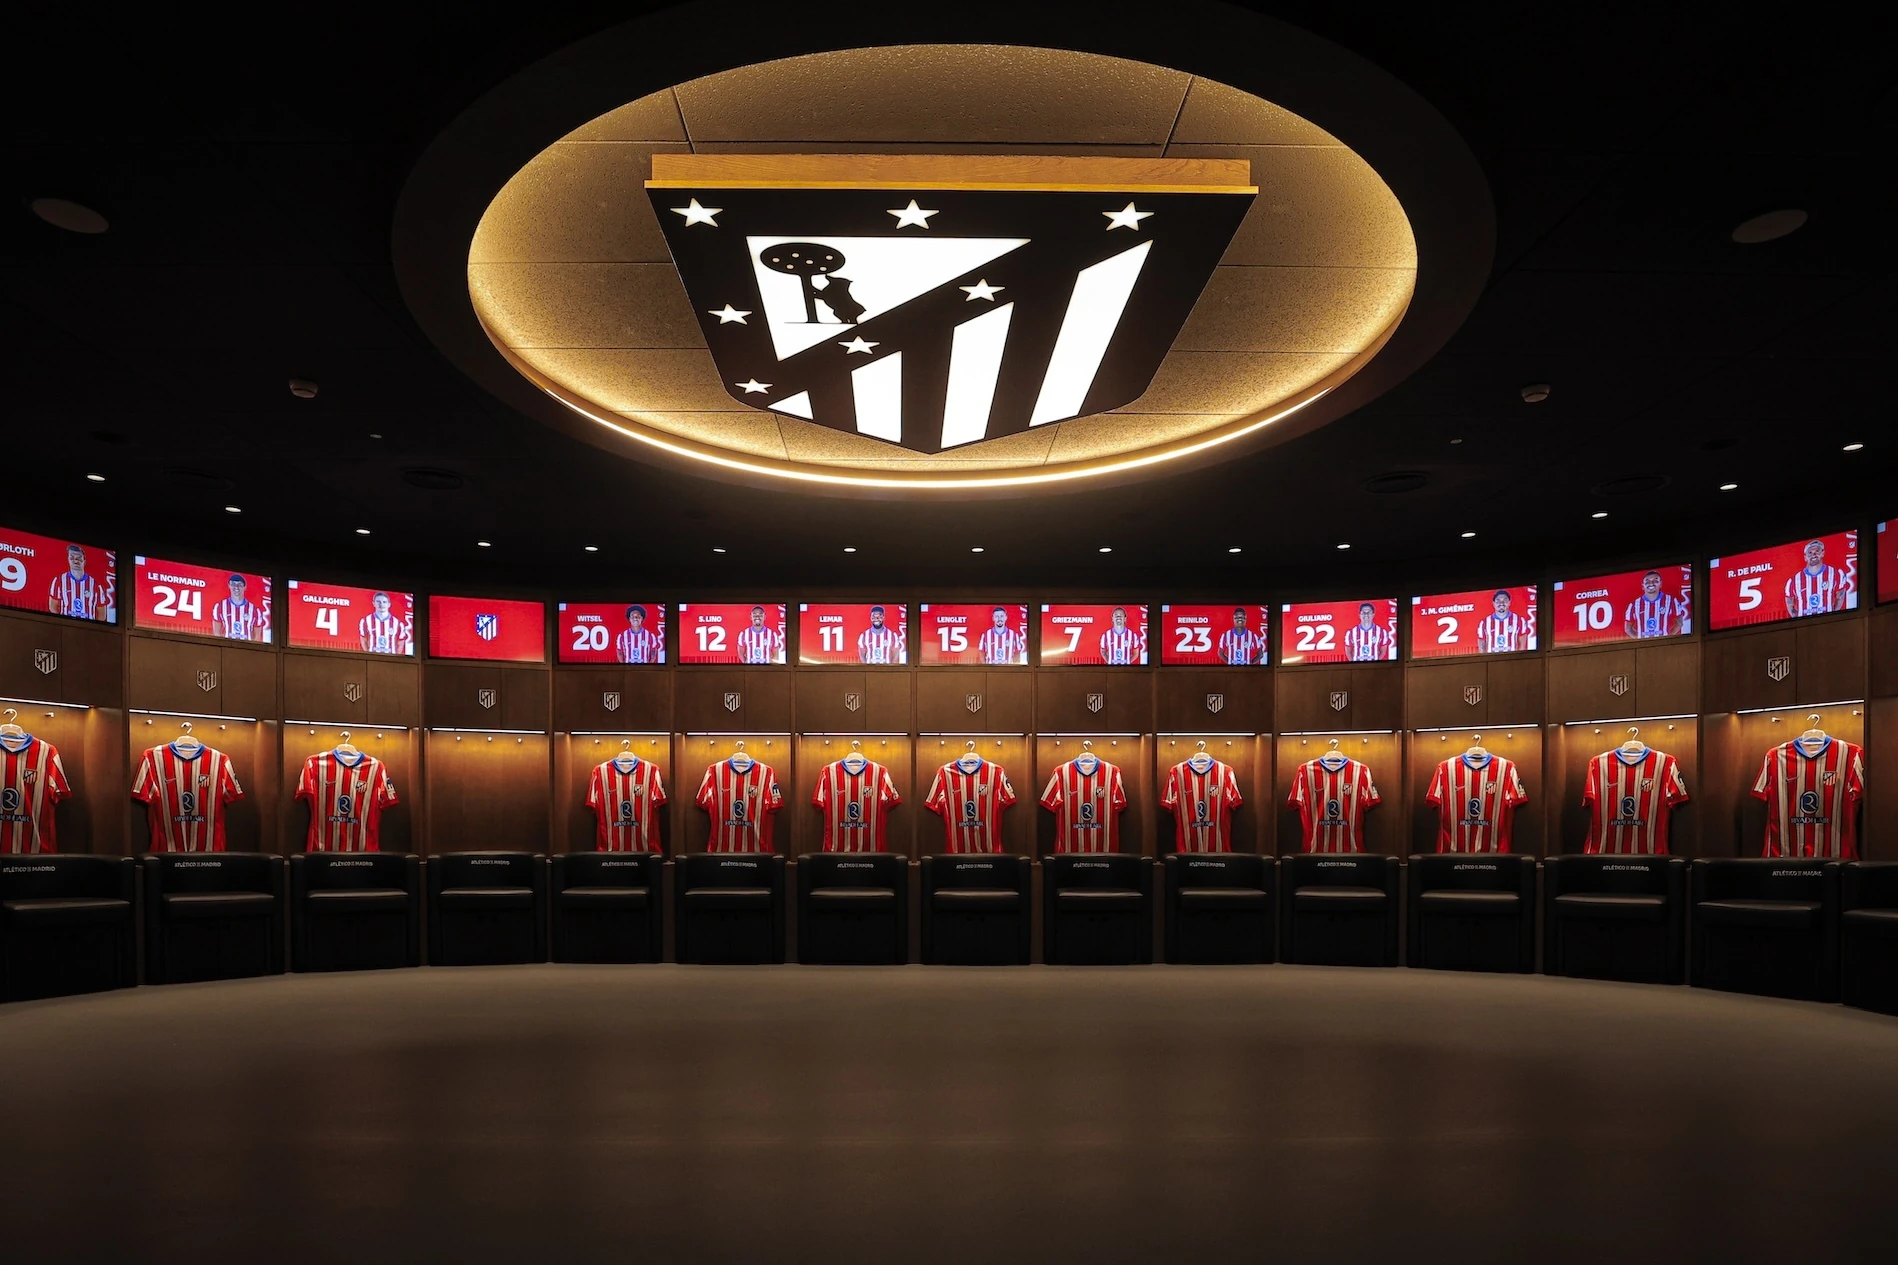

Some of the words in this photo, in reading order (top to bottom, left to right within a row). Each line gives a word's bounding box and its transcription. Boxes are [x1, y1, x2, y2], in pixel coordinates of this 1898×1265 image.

[0, 557, 27, 591] 9
[148, 571, 159, 580] LE
[160, 574, 206, 588] NORMAND
[1738, 567, 1749, 576] DE
[1750, 563, 1773, 574] PAUL
[152, 585, 202, 621] 24
[303, 594, 350, 607] GALLAGHER
[1576, 589, 1609, 600] CORREA
[1738, 577, 1763, 611] 5
[315, 607, 339, 636] 4
[698, 615, 705, 623] S.
[706, 615, 722, 623] LINO
[819, 615, 843, 623] LEMAR
[1052, 616, 1094, 624] GRIEZMANN
[1298, 614, 1333, 623] GIULIANO
[1438, 604, 1474, 614] GIMÉNEZ
[1573, 600, 1613, 631] 10
[572, 626, 610, 651] 20
[695, 626, 727, 651] 12
[819, 626, 844, 652] 11
[937, 627, 968, 652] 15
[1064, 627, 1083, 653] 7
[1175, 627, 1212, 653] 23
[1295, 624, 1336, 651] 22
[1436, 616, 1459, 644] 2
